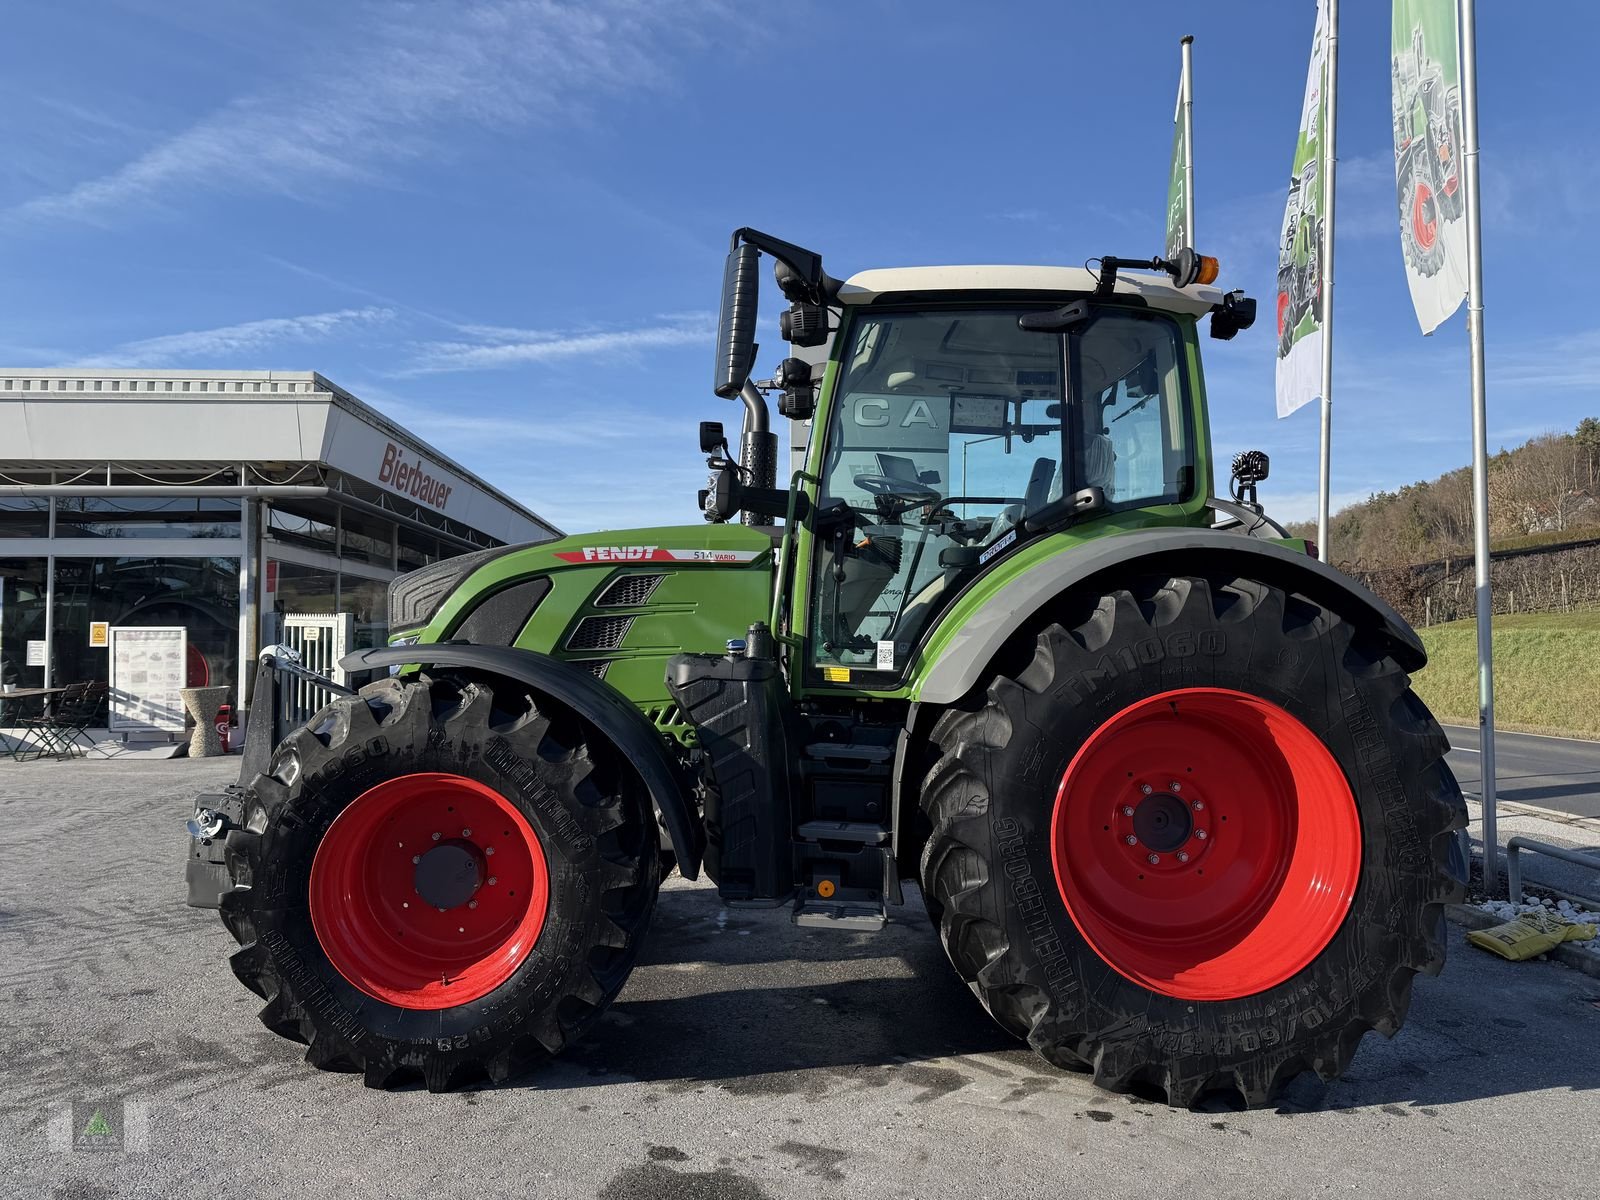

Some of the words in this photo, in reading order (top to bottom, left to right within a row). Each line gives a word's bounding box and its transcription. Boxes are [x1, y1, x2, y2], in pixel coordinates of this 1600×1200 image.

[803, 398, 939, 429] CA
[378, 442, 452, 510] Bierbauer
[582, 545, 658, 560] FENDT
[1052, 630, 1228, 708] TM1060
[487, 736, 592, 852] TRELLEBORG
[992, 816, 1080, 1006] TRELLEBORG
[262, 928, 368, 1049] TRELLEBORG
